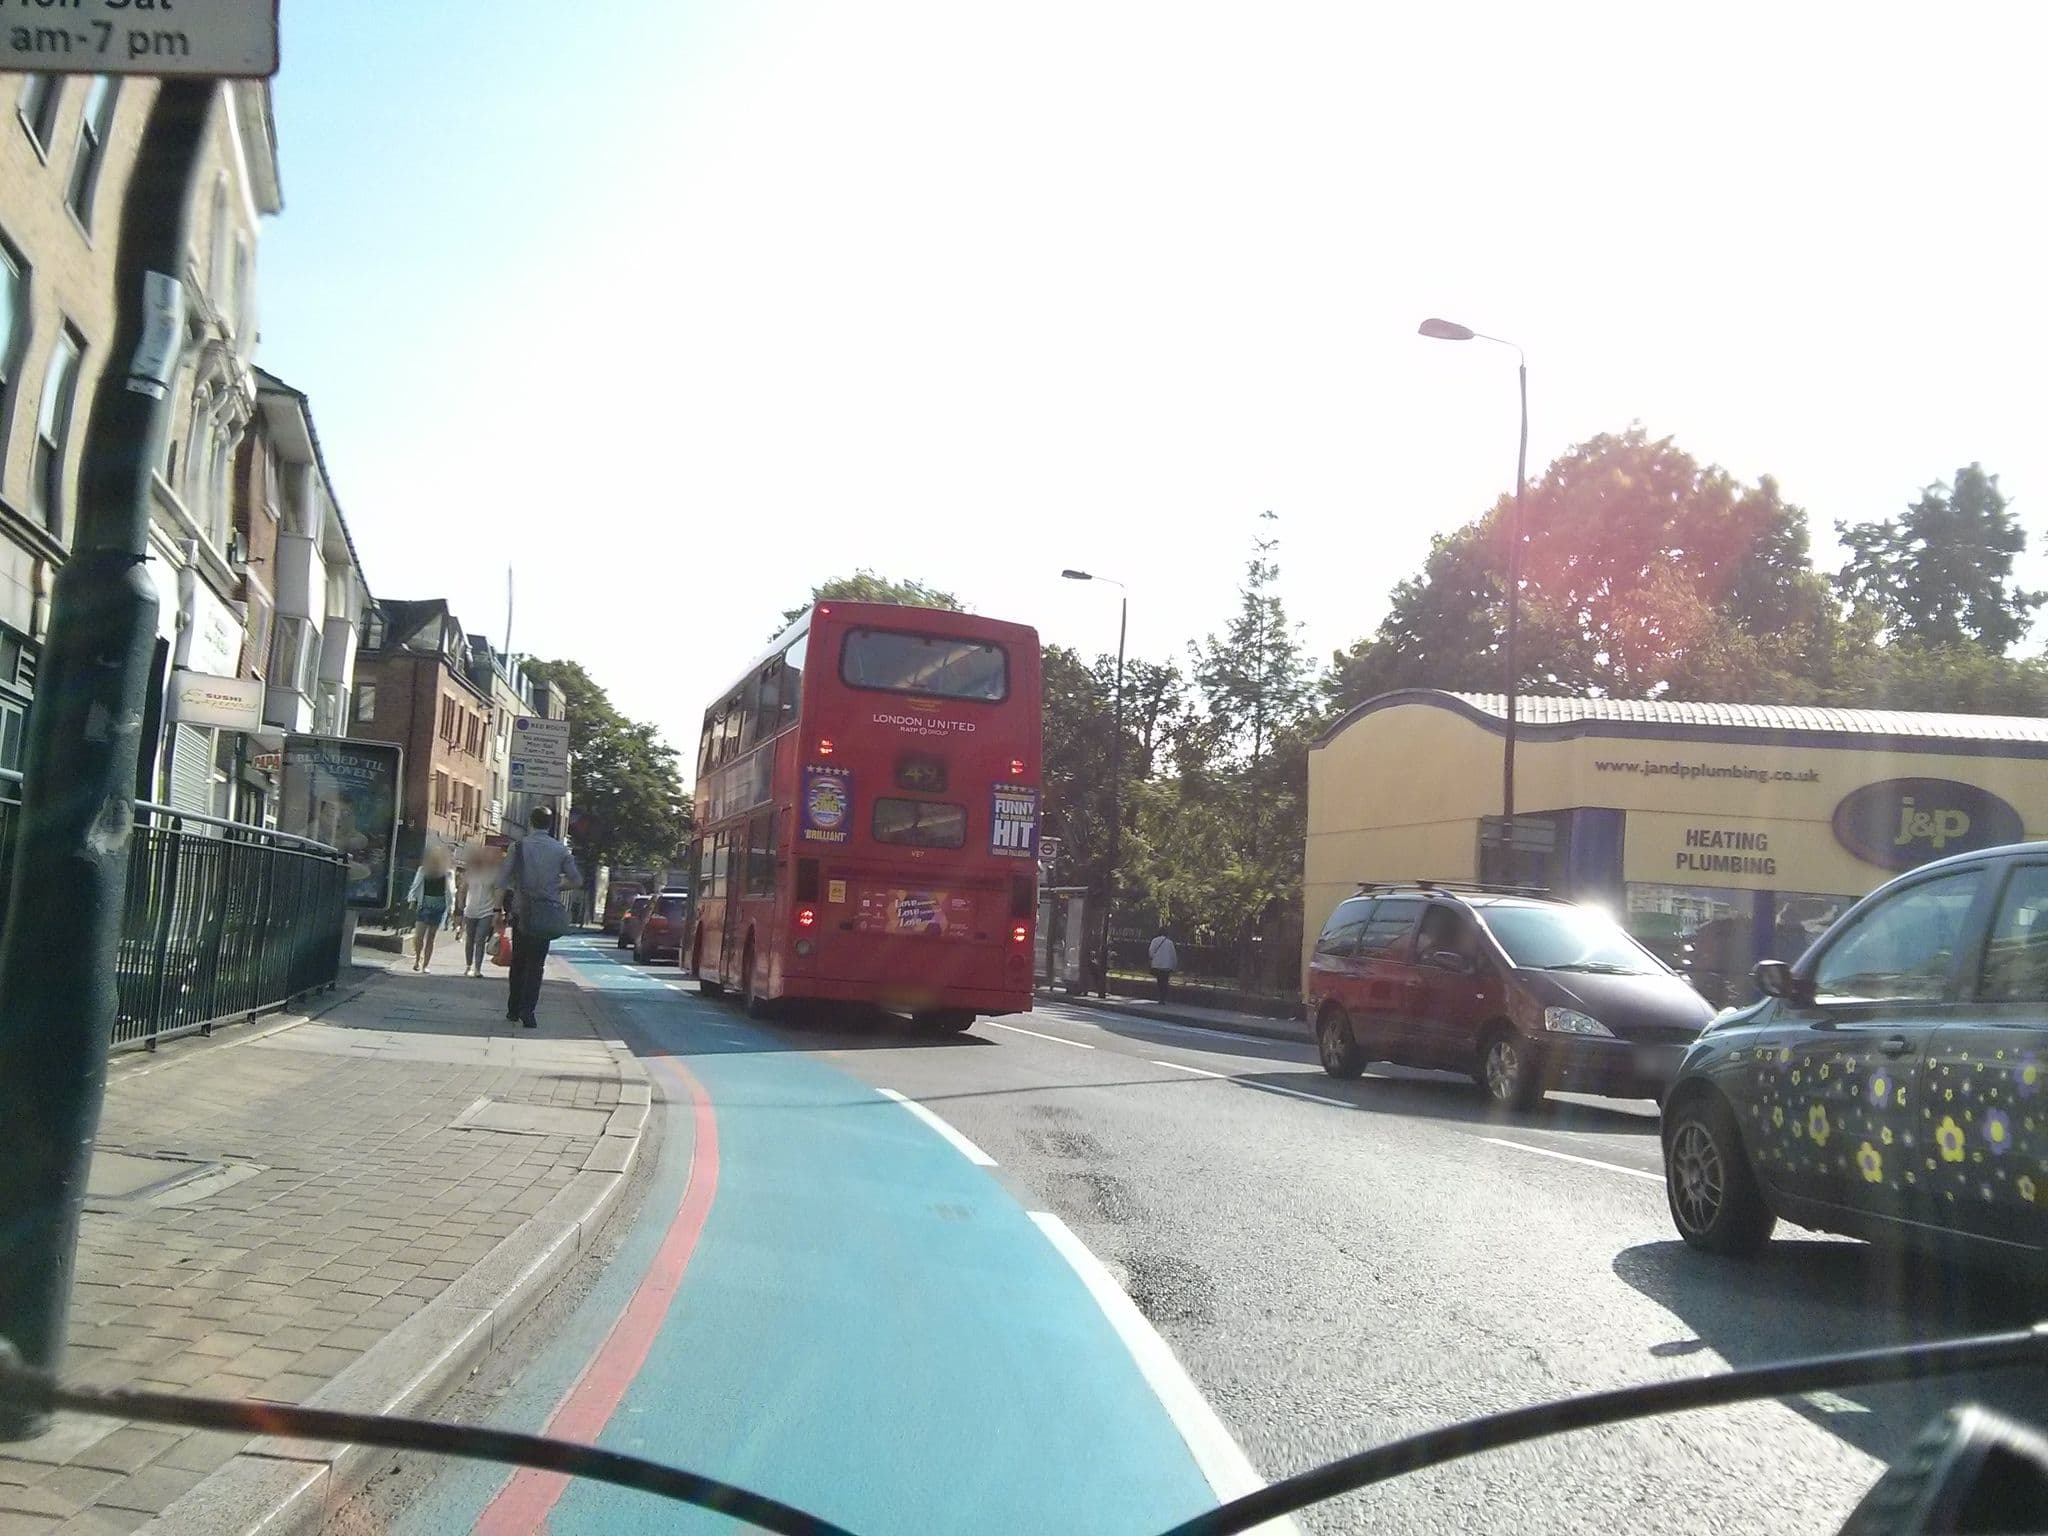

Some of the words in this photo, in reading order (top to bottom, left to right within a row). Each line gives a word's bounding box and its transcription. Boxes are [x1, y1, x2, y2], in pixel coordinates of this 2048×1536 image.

[128, 29, 190, 60] pm
[206, 693, 242, 702] SUSHI
[873, 713, 922, 726] LONDON
[927, 719, 976, 732] UNITED
[1595, 760, 1820, 783] www.jandpplumbing.co.uk
[995, 800, 1034, 815] FUNNY
[993, 820, 1034, 848] HIT
[1894, 796, 1971, 849] j&p
[1686, 828, 1768, 851] HEATING
[1676, 852, 1776, 875] PLUMBING
